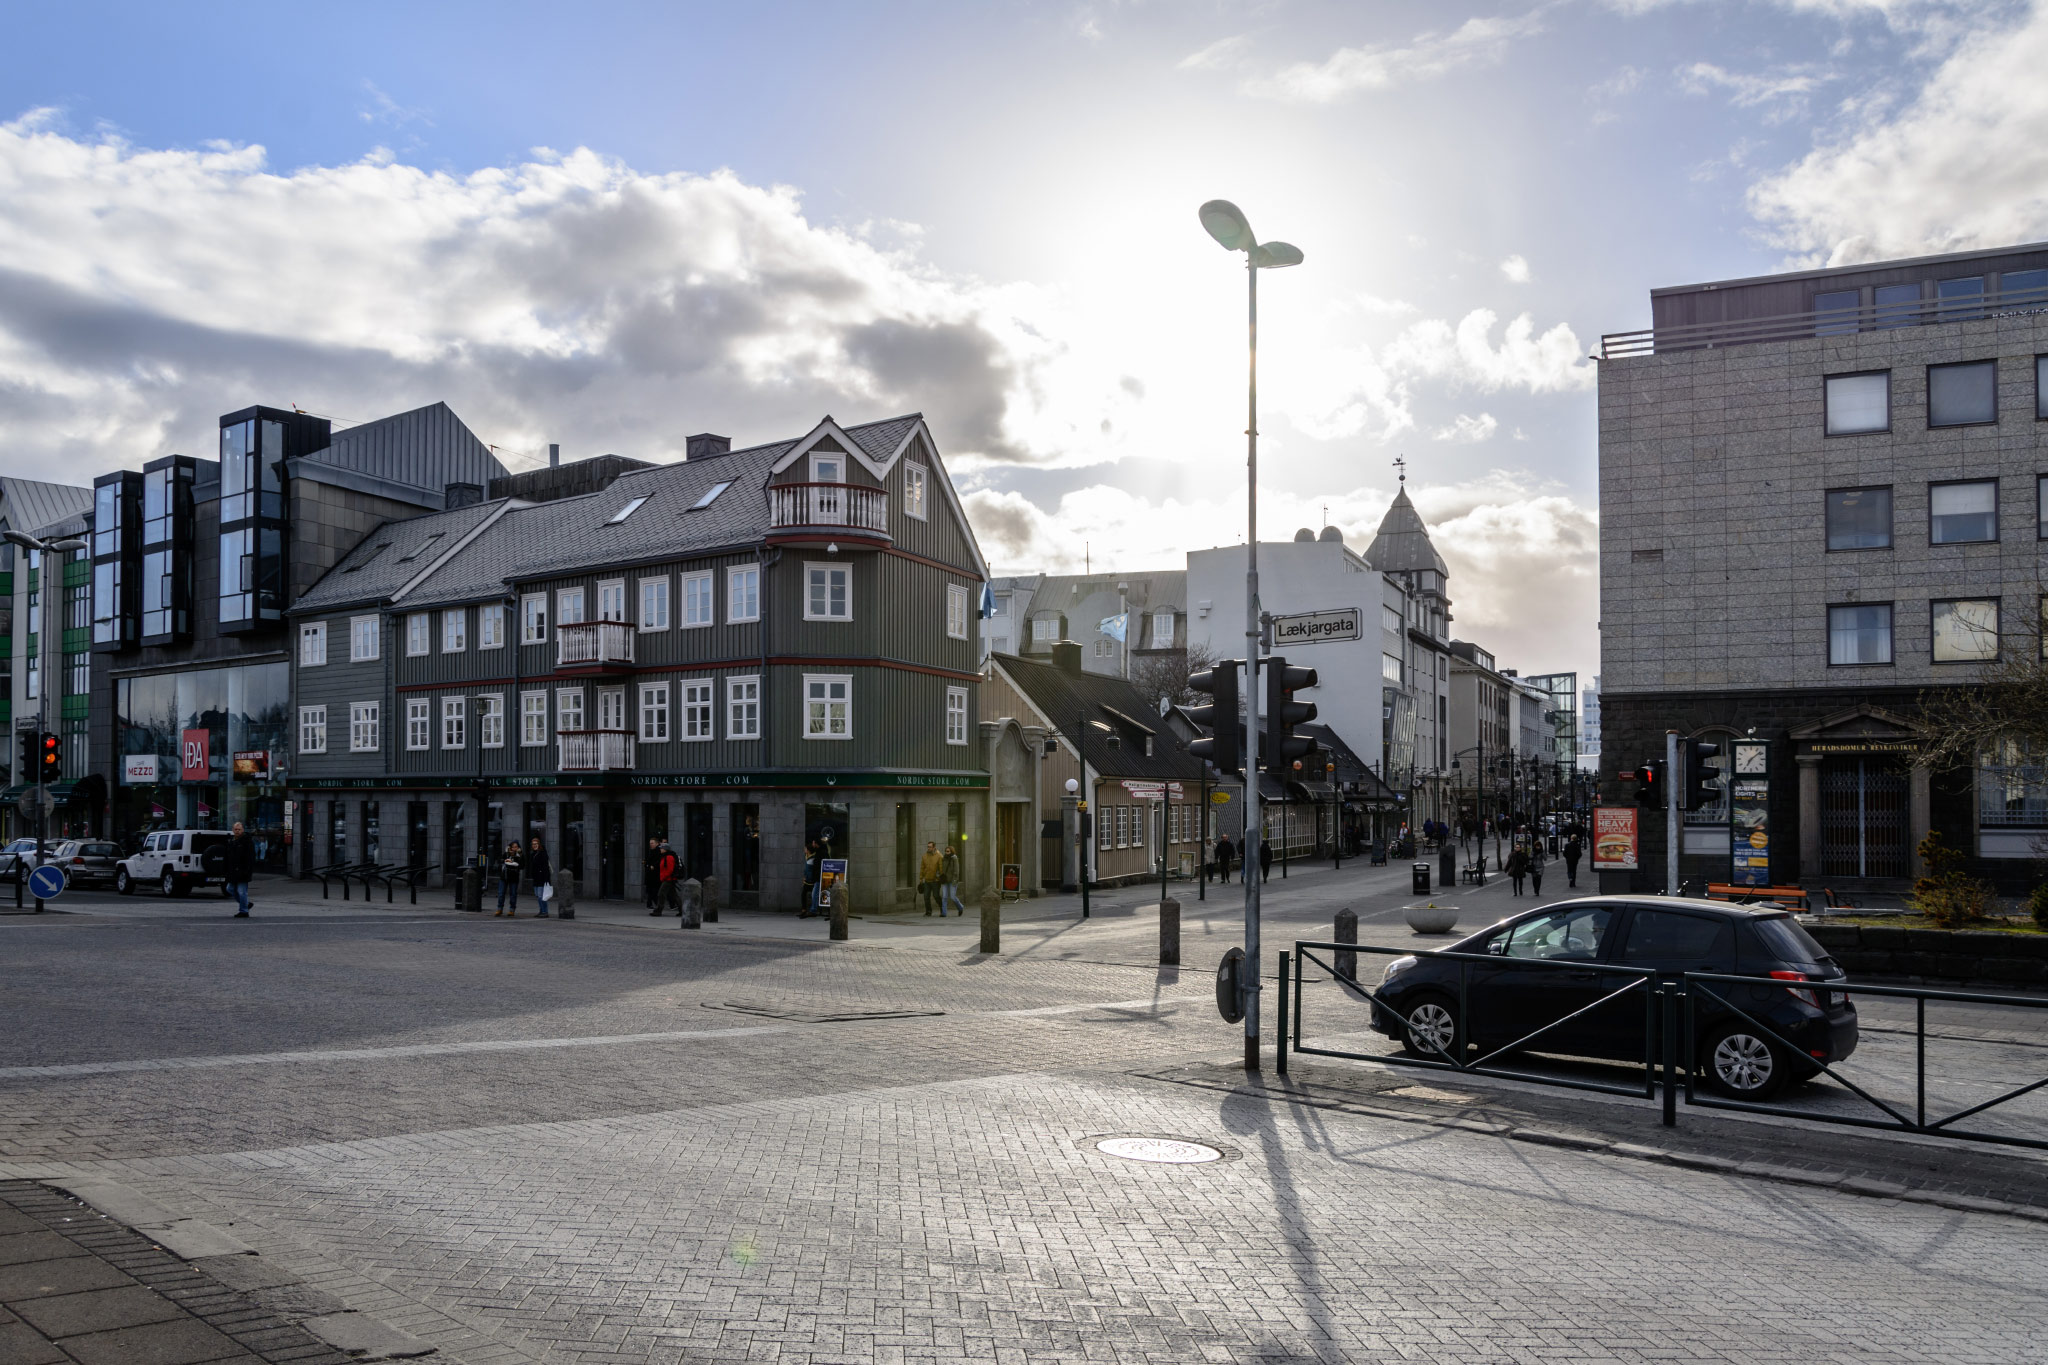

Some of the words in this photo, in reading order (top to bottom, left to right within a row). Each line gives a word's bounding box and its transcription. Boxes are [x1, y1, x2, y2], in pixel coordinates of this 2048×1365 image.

[1278, 619, 1354, 637] Lækjargata
[128, 767, 153, 776] MEZZO
[318, 779, 344, 787] NORDIC
[352, 779, 375, 787] STORE
[512, 777, 539, 786] STORE
[630, 776, 668, 785] NORDIC
[674, 776, 707, 785] STORE
[721, 775, 750, 785] .COM
[897, 775, 924, 785] NORDIC
[928, 776, 949, 785] STORE
[952, 777, 970, 786] .COM
